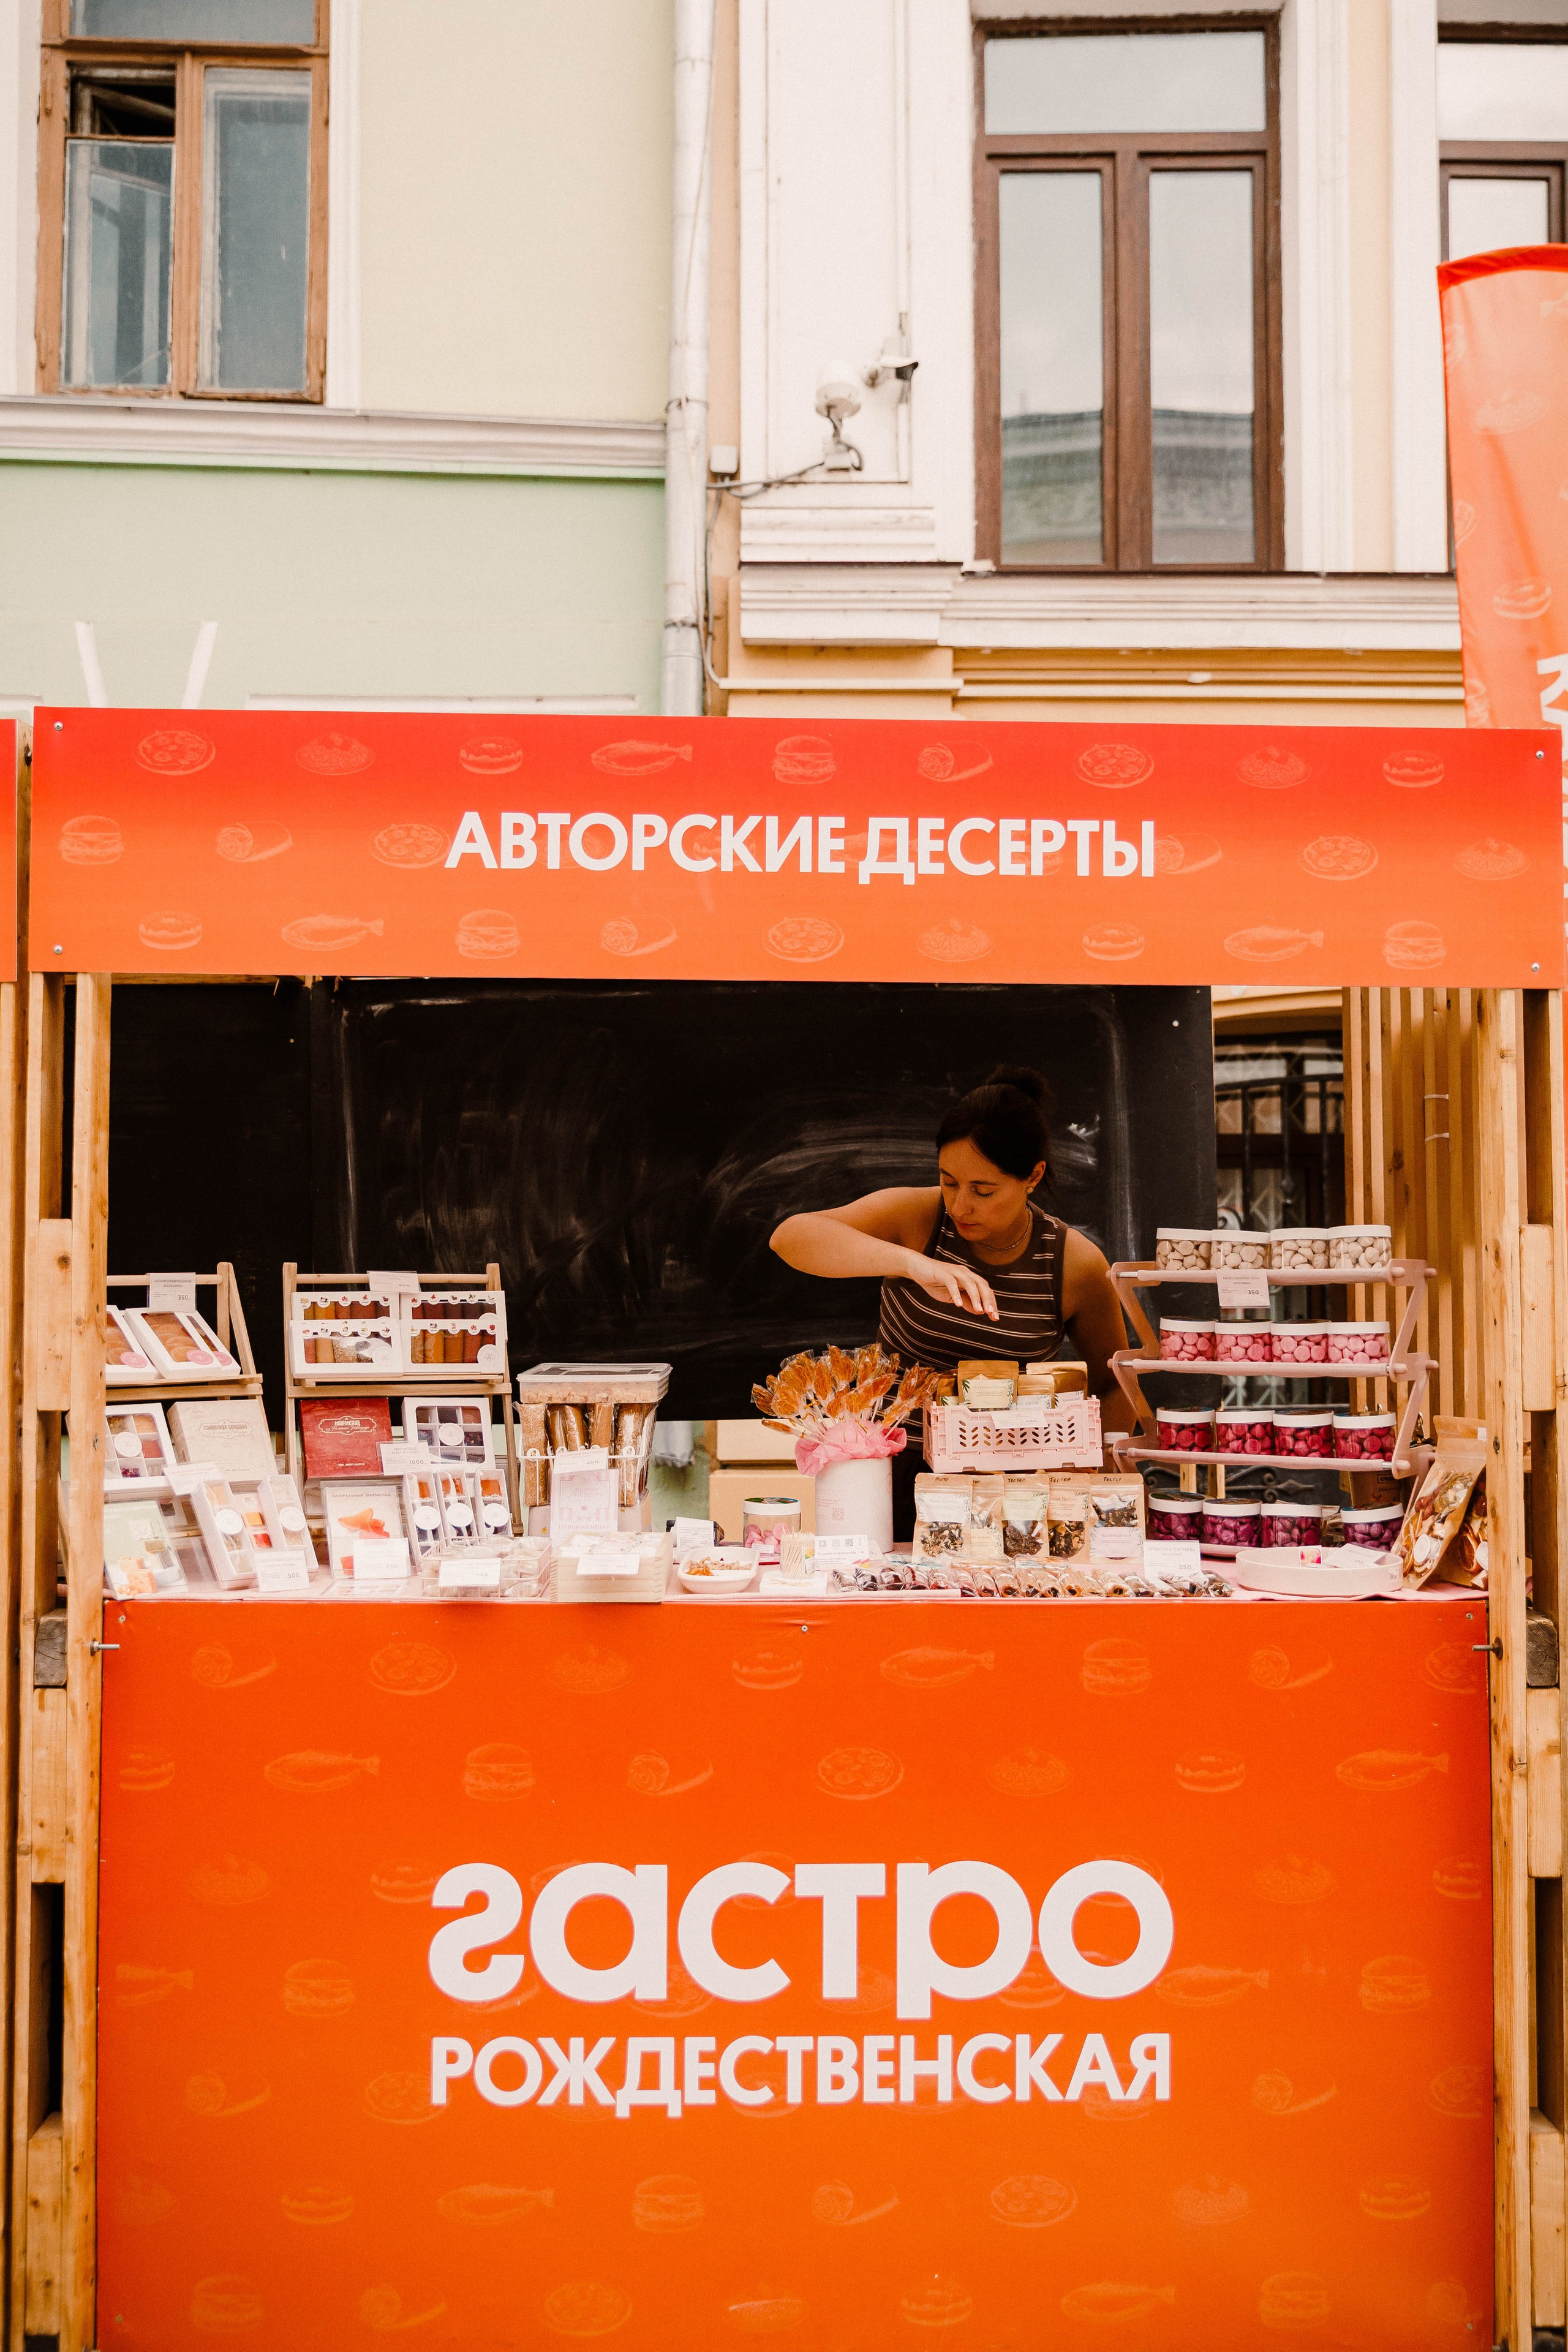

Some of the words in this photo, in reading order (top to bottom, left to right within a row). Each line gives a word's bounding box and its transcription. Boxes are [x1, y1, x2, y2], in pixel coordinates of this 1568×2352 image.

[444, 810, 845, 874] АВТОРСКИЕ
[858, 815, 1155, 885] ДЕСЕРТЫ
[428, 1859, 1174, 2019] гастро
[430, 2032, 1171, 2118] РОЖДЕСТВЕНСКАЯ
